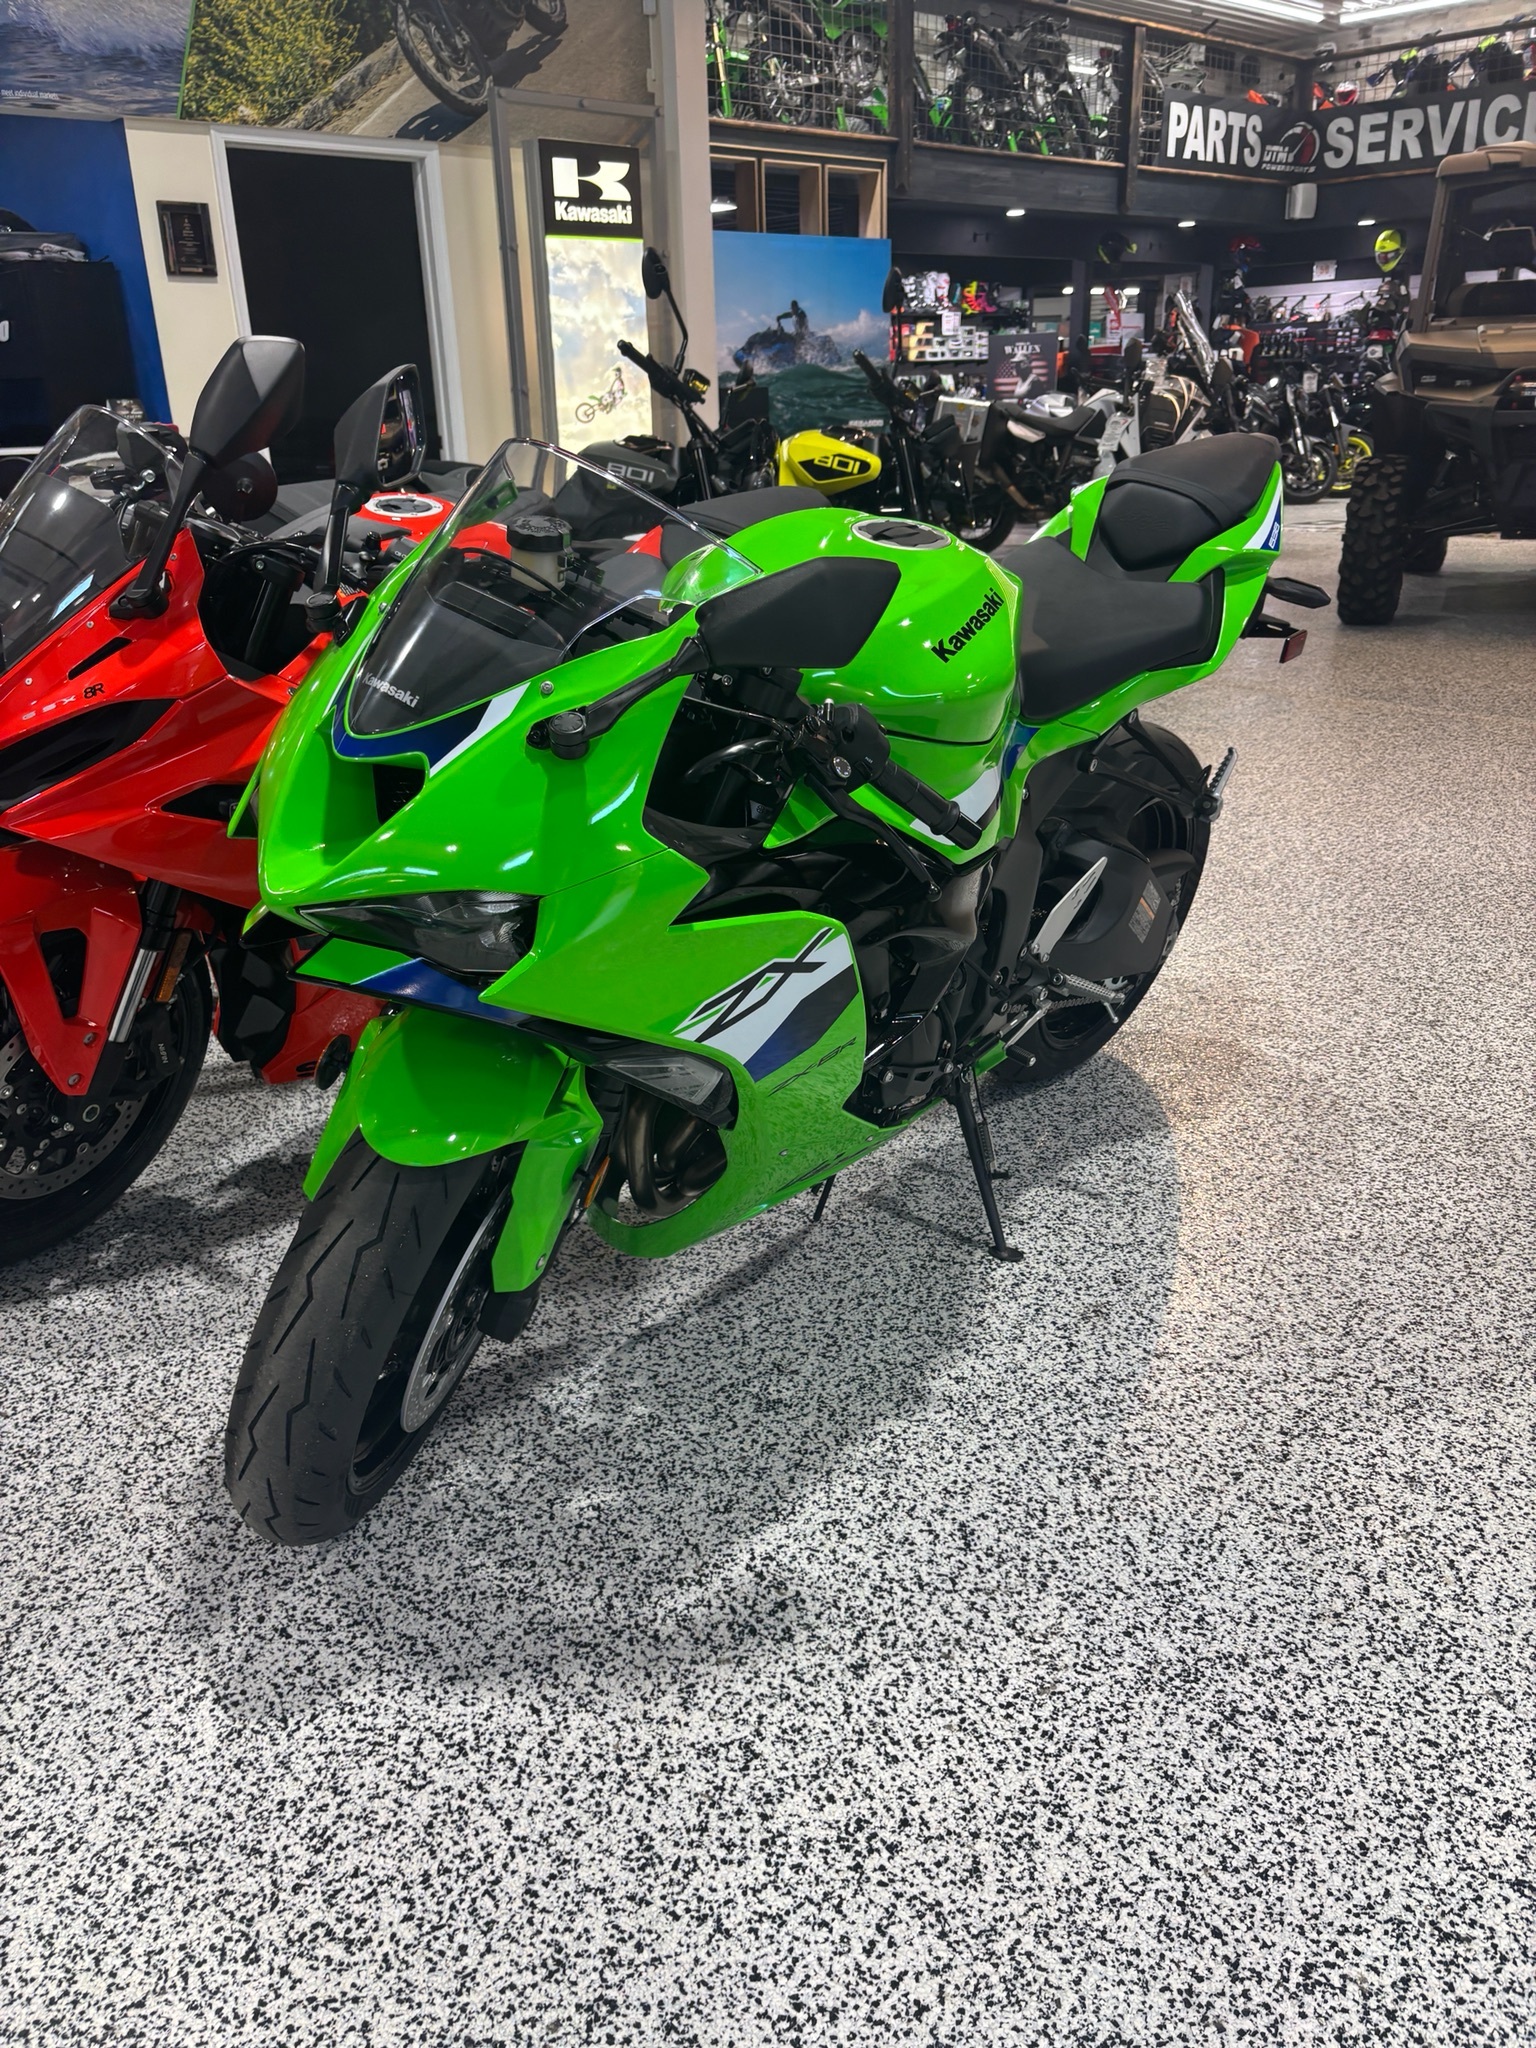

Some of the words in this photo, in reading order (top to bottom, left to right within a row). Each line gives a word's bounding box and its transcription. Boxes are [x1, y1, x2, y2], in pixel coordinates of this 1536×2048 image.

[1166, 101, 1263, 168] PARTS
[1261, 162, 1317, 174] POWERSPORTS
[554, 200, 633, 225] Kawasaki
[813, 455, 861, 475] 801
[931, 587, 1005, 664] Kawasaki
[83, 682, 106, 699] 8R
[362, 672, 420, 709] Kawasaki
[688, 927, 833, 1044] ZX
